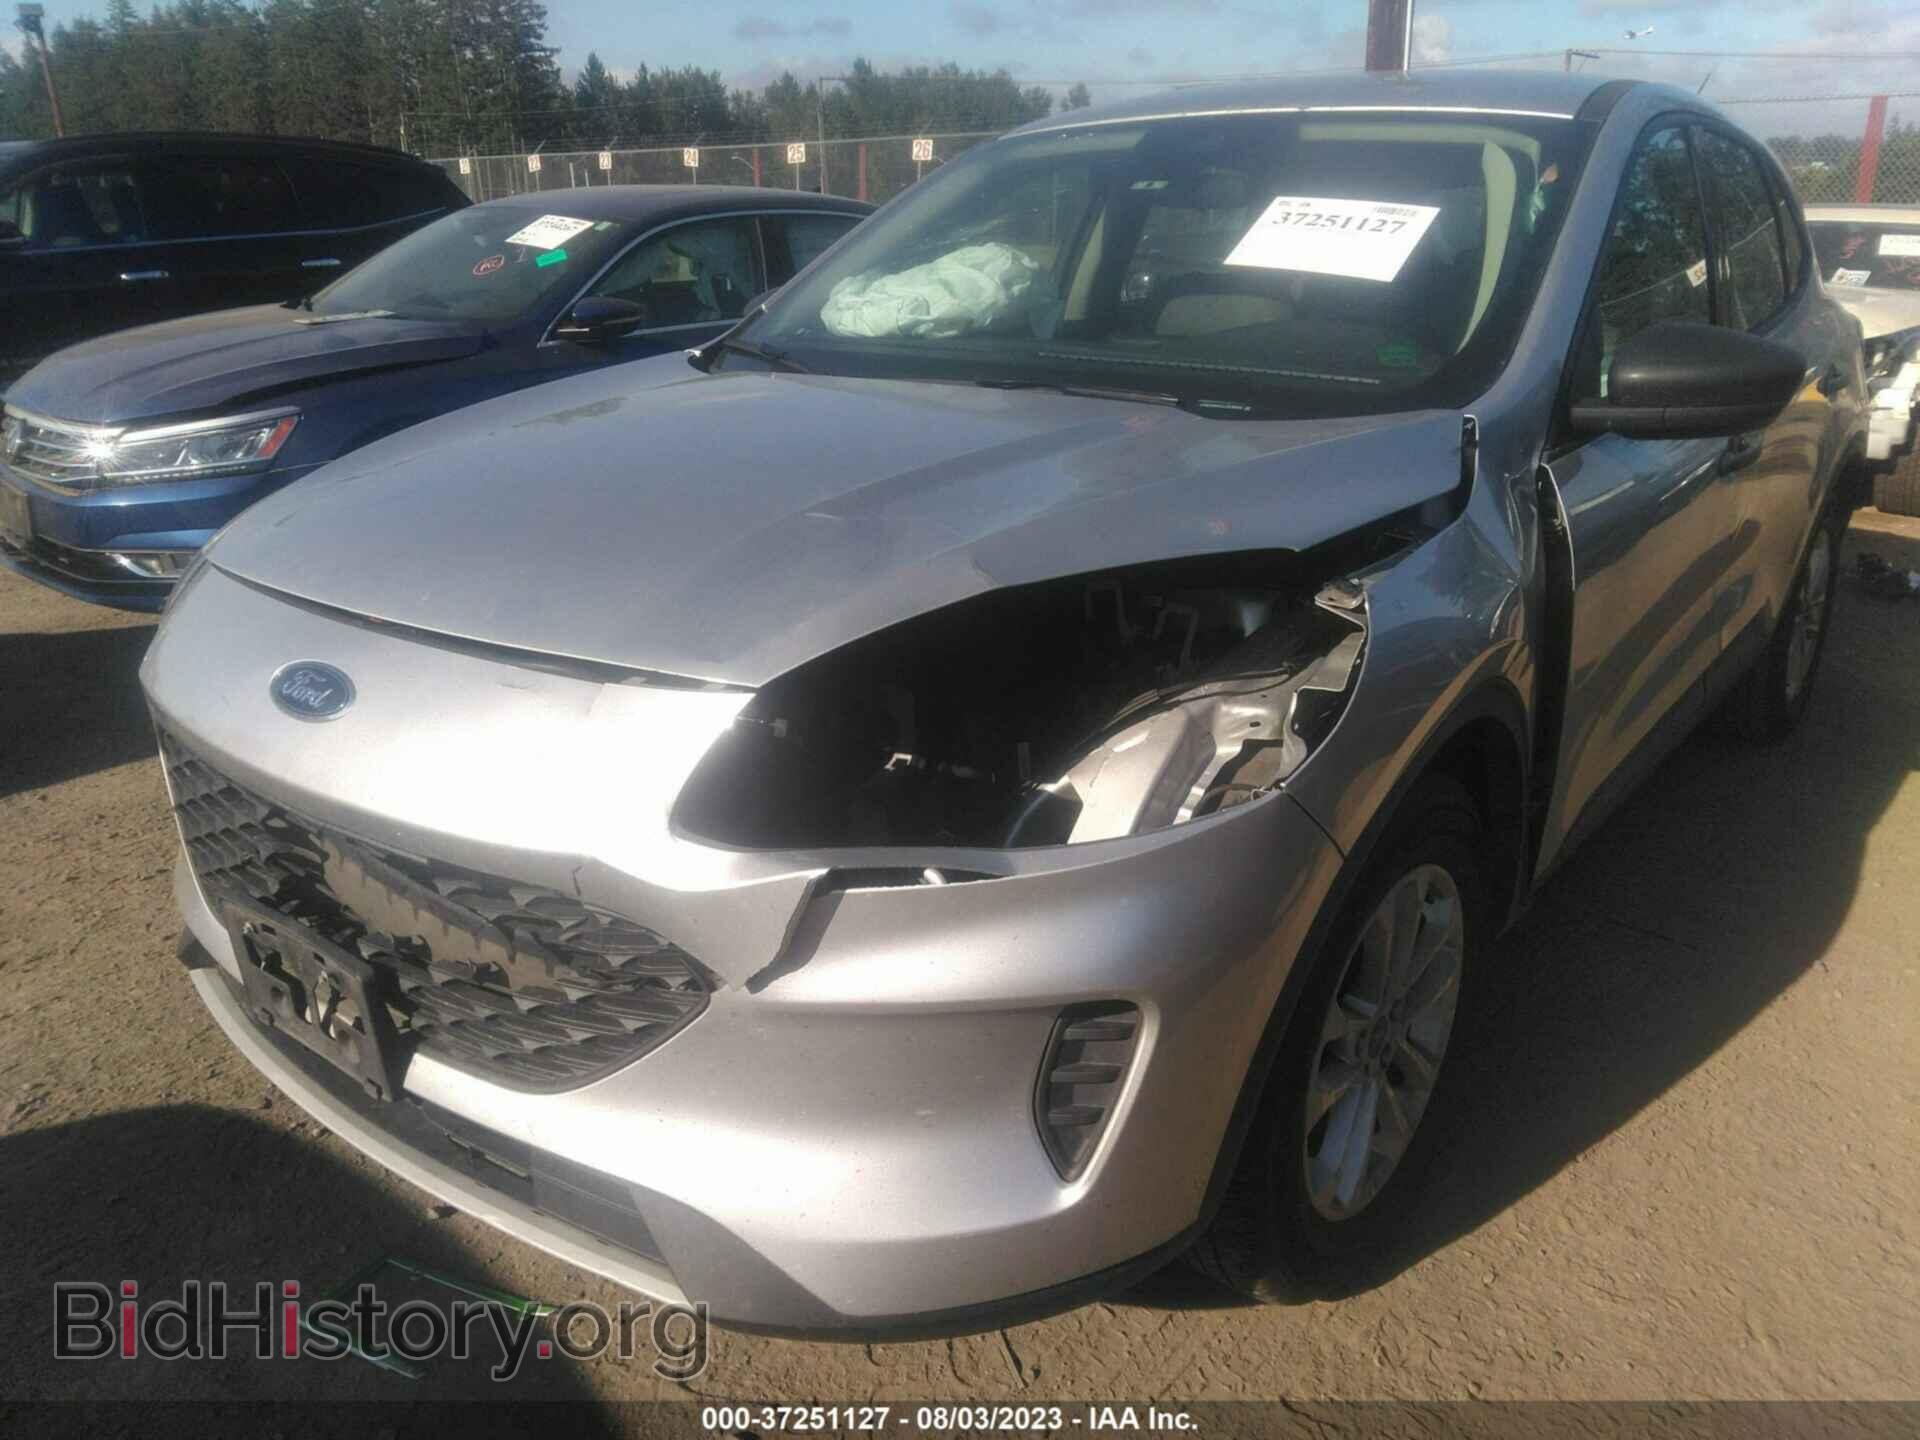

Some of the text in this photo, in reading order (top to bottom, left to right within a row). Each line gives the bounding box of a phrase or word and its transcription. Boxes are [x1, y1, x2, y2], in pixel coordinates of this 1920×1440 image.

[685, 149, 697, 165] 24
[789, 144, 804, 161] 25
[914, 140, 931, 159] 26
[1271, 211, 1408, 235] 37251127
[282, 671, 334, 707] Ford
